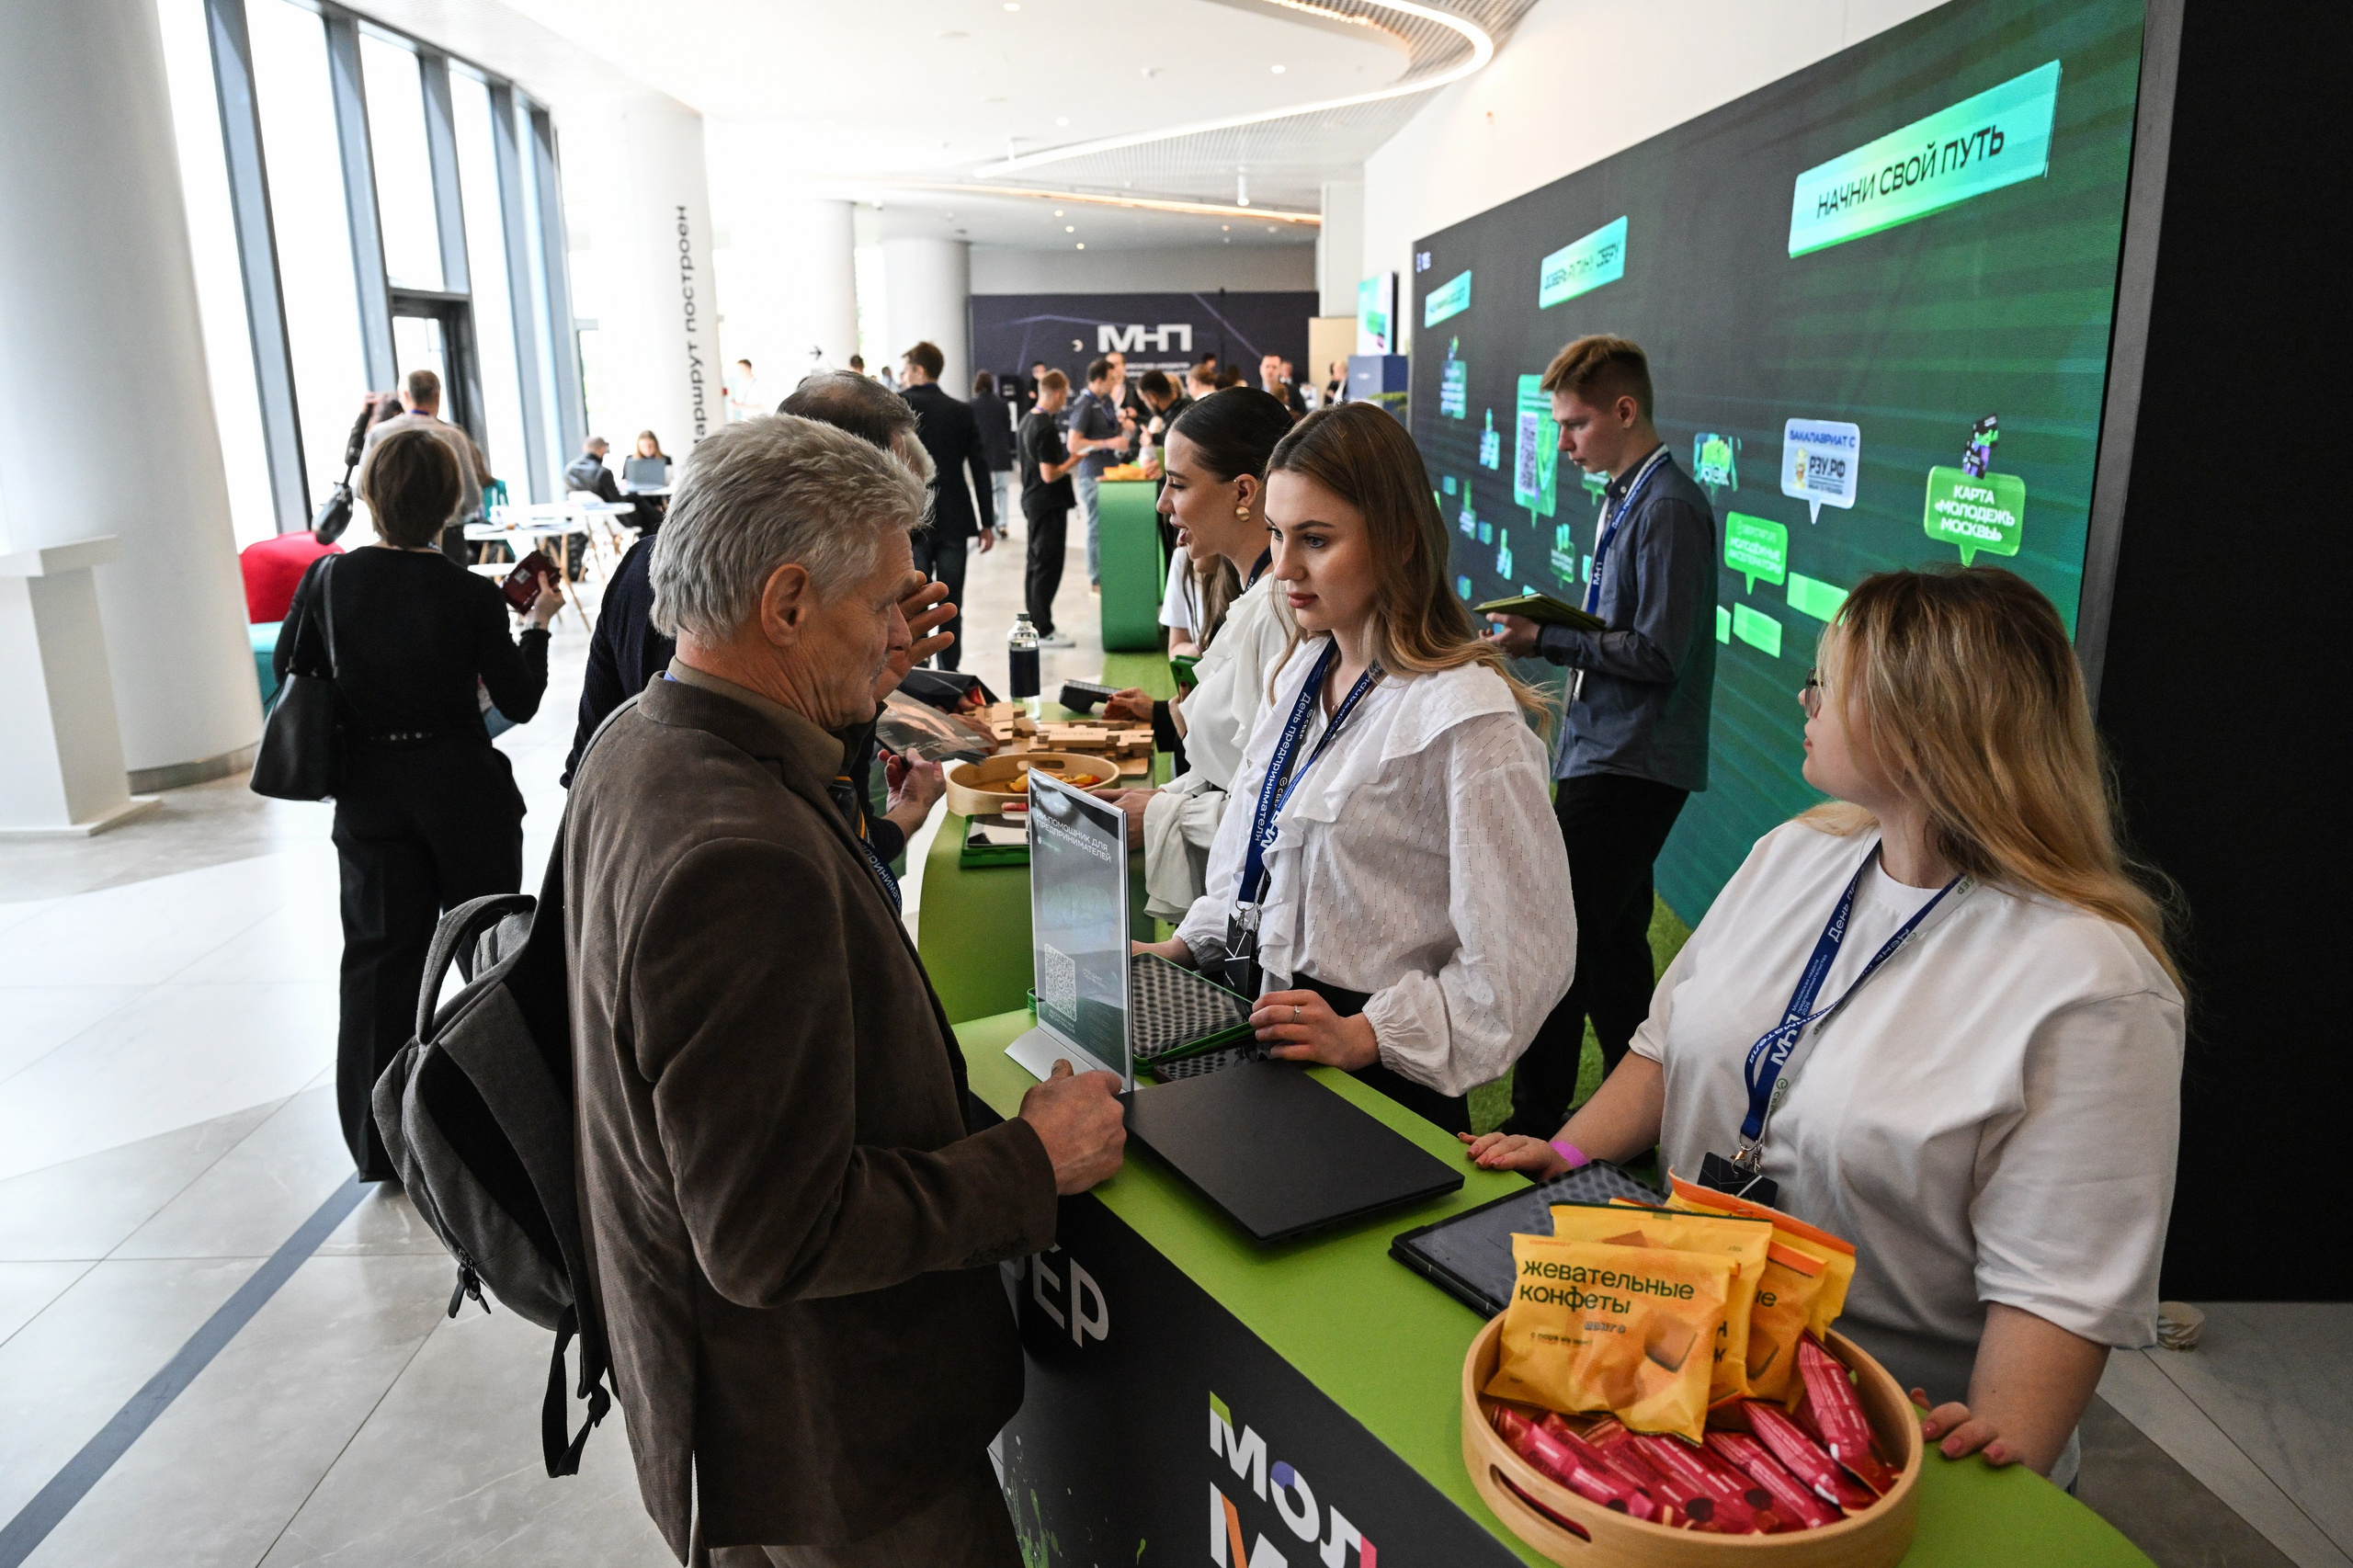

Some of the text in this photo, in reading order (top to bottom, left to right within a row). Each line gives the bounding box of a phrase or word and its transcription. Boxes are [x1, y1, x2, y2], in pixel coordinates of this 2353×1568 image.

[1816, 124, 2005, 219] НАЧНИ СВОЙ ПУТЬ
[676, 205, 709, 445] аршрут построен
[1097, 324, 1192, 353] МНП
[1953, 484, 1995, 505] КАРТА
[1292, 692, 1312, 723] День
[1255, 725, 1297, 842] предпринимателя
[1036, 810, 1108, 852] ИИ-ПОМОЩНИК ДЛЯ
[1036, 820, 1112, 863] ПРЕДПРИНИМАТЕЛЕЙ
[1827, 903, 1849, 943] День
[1008, 1243, 1109, 1348] ЕР
[1519, 1284, 1631, 1314] конфеты
[1522, 1260, 1695, 1301] жевательные
